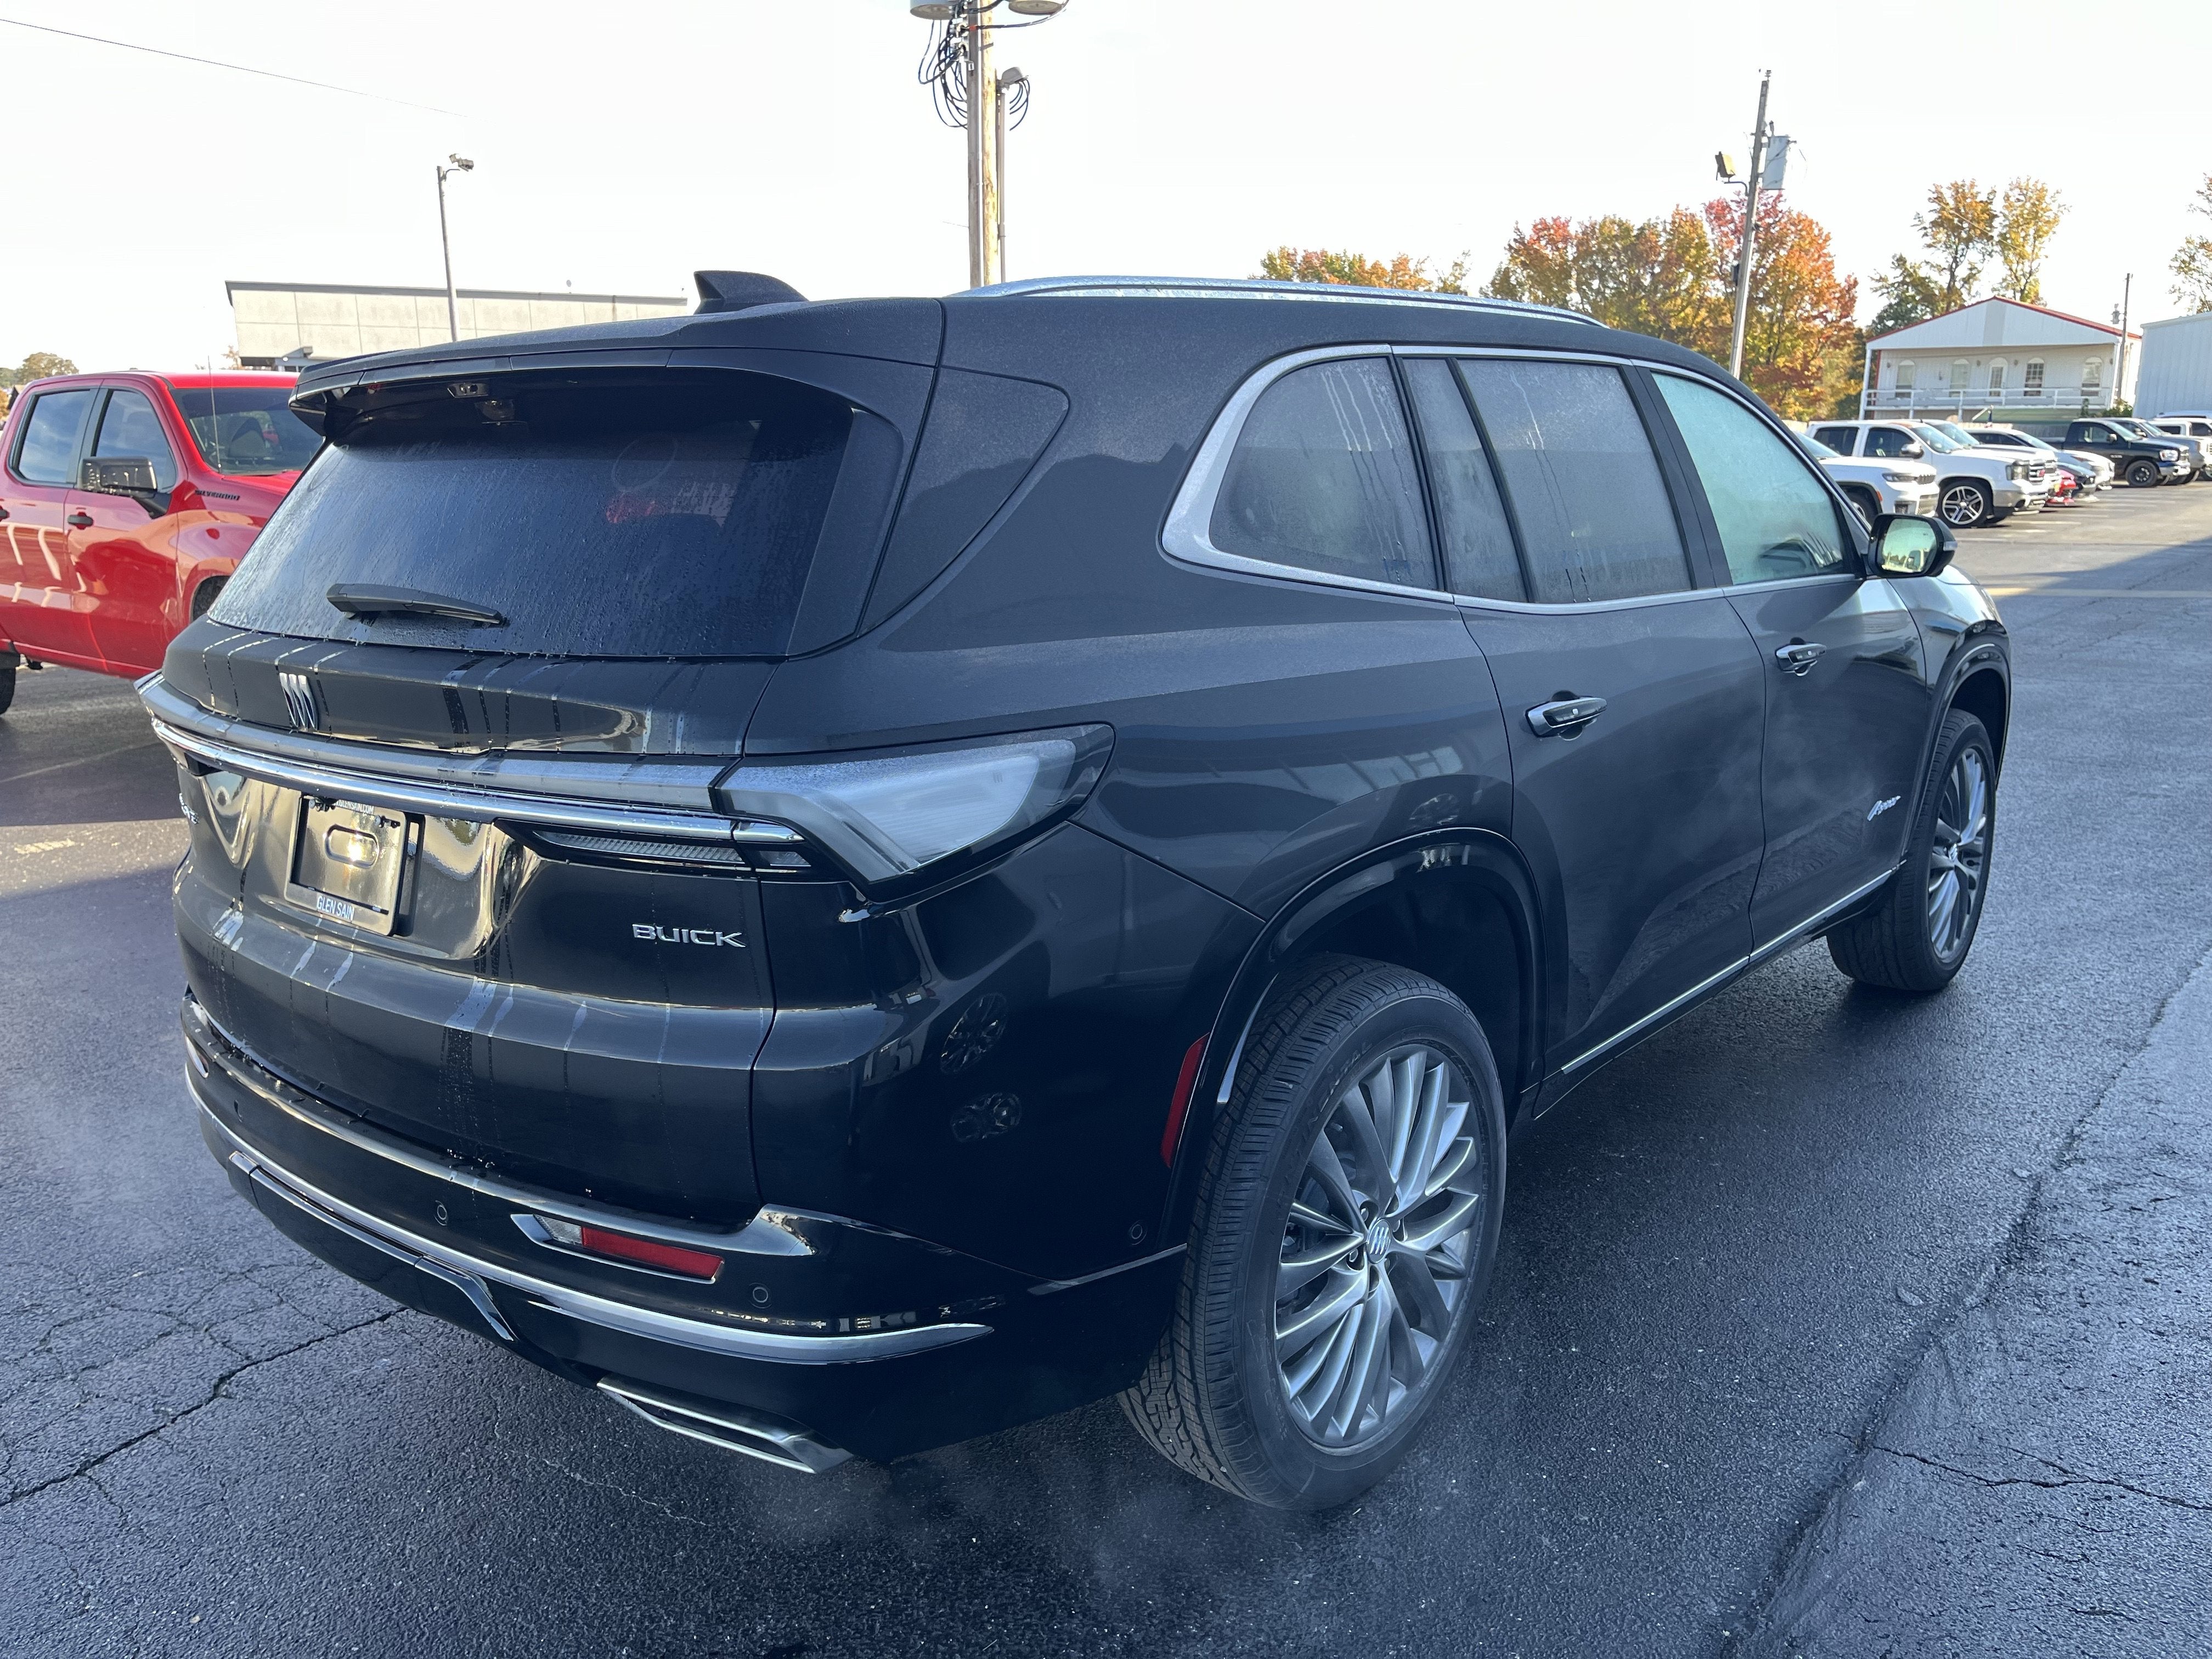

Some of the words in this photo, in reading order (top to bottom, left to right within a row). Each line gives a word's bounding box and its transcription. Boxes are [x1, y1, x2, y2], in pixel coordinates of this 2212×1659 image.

[317, 895, 336, 915] GLEN
[336, 902, 355, 921] SAIN
[632, 924, 747, 947] BUICK
